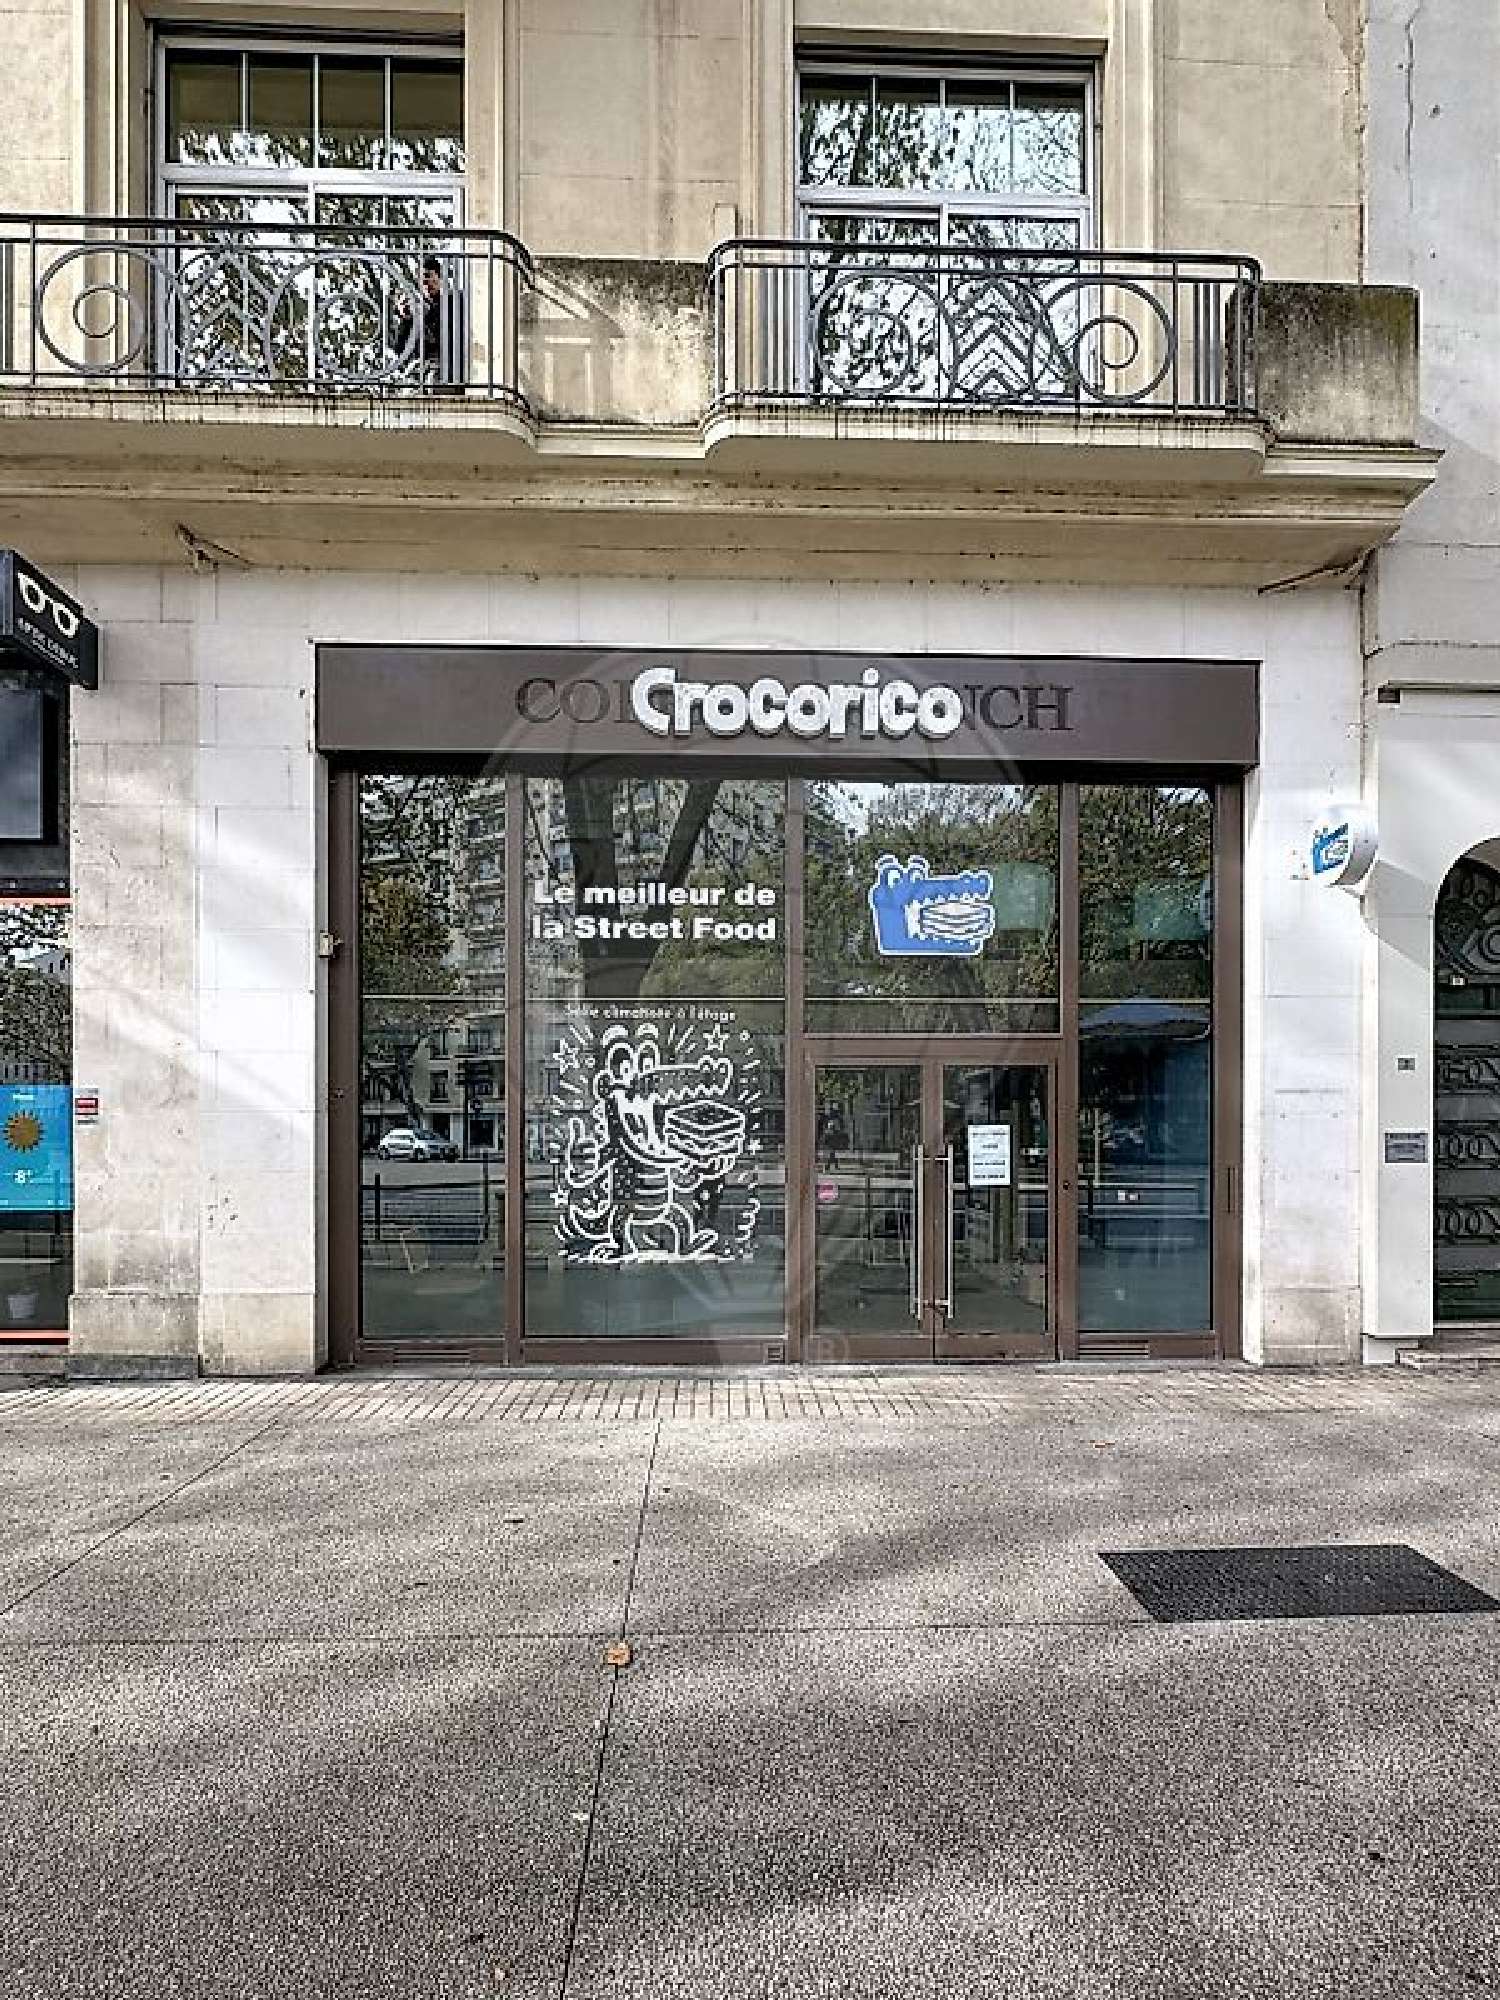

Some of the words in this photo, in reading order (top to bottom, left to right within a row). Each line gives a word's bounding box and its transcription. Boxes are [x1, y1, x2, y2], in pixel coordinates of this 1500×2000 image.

[632, 667, 963, 738] Crocorico
[534, 880, 574, 904] Le
[584, 882, 725, 905] meilleur
[734, 882, 776, 905] de
[532, 914, 564, 939] la
[574, 916, 684, 939] Street
[692, 917, 776, 940] Food
